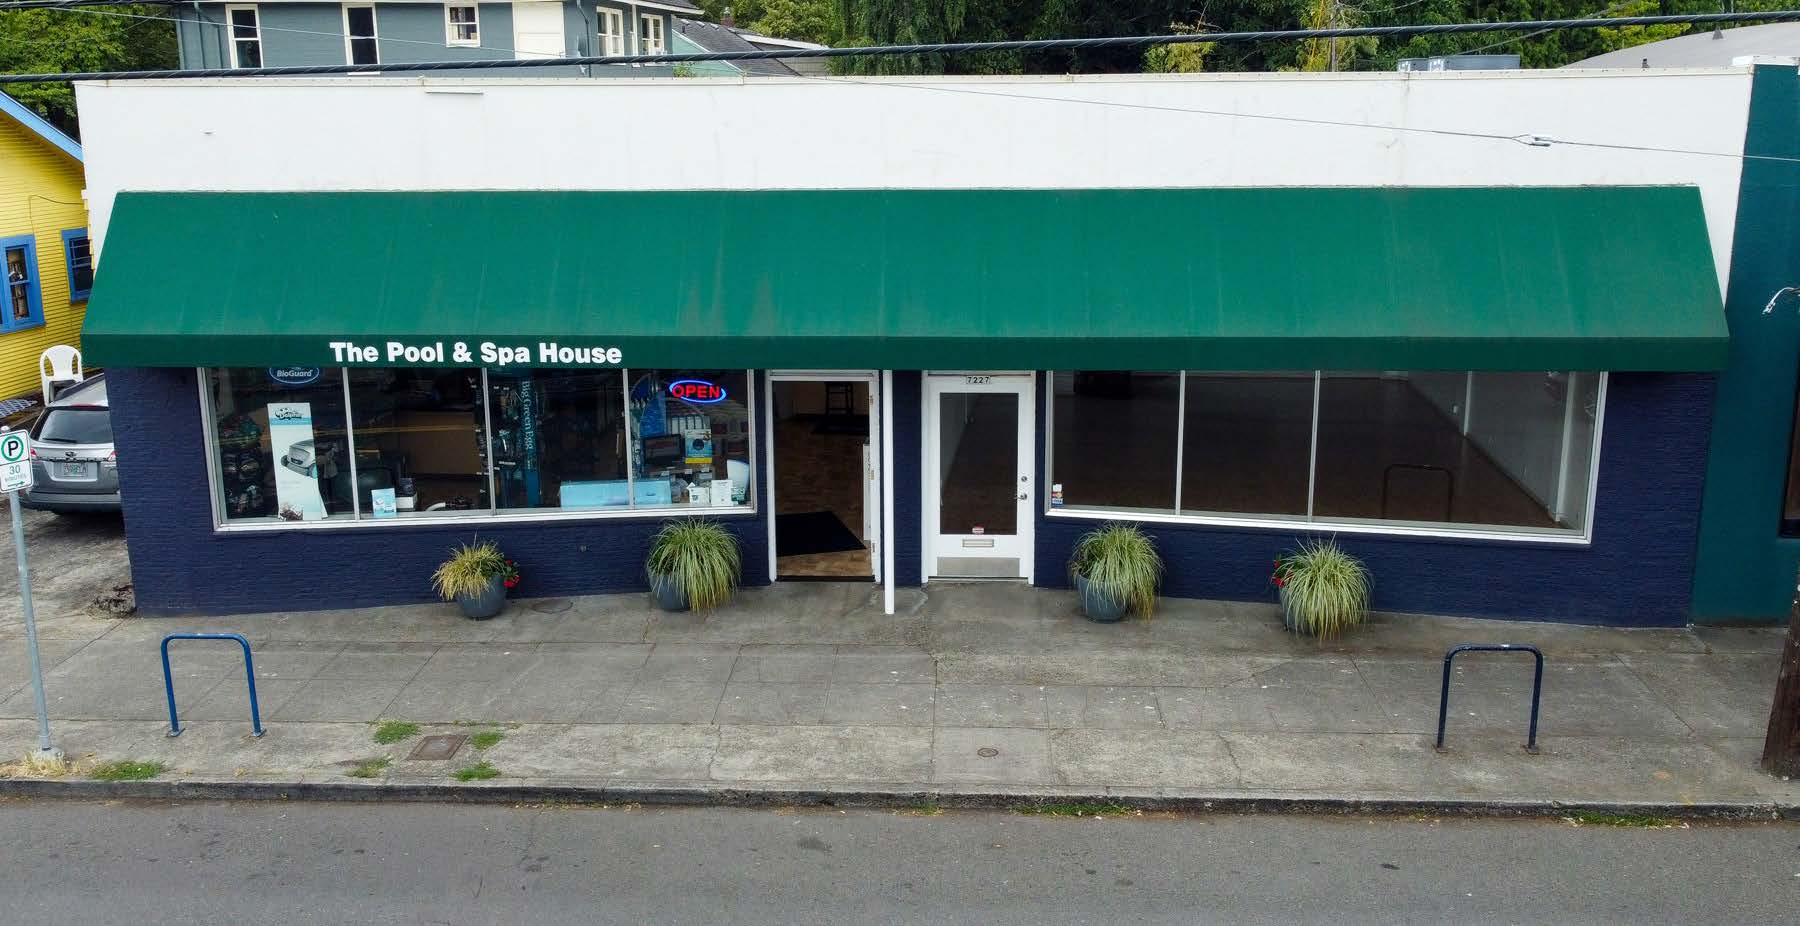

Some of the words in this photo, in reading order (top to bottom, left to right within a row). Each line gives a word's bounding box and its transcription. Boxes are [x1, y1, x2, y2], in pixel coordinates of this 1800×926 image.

[330, 342, 378, 363] The
[387, 342, 444, 363] Pool
[453, 342, 473, 363] &
[480, 342, 530, 366] Spa
[539, 343, 622, 364] House
[276, 369, 313, 377] BioGuard
[967, 376, 989, 384] 7227
[522, 381, 531, 398] Big
[671, 385, 720, 398] OPEN
[523, 399, 532, 430] Green
[7, 440, 19, 457] P
[9, 465, 21, 475] 30
